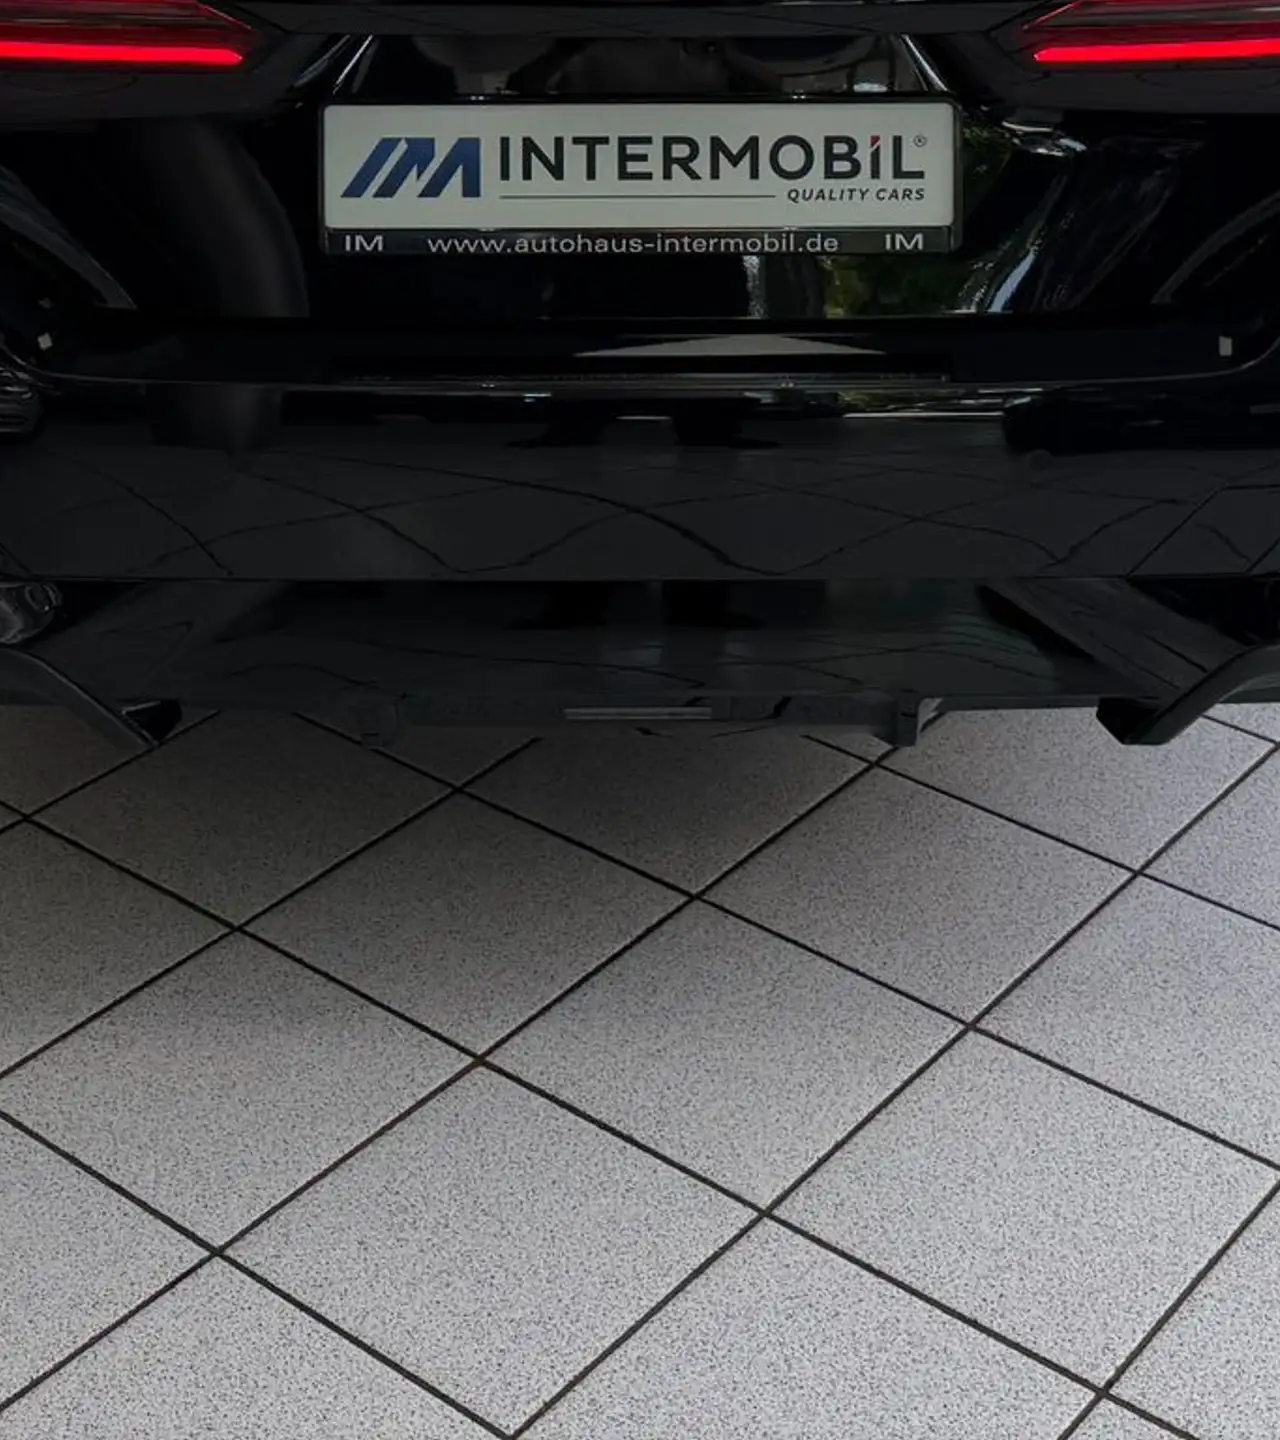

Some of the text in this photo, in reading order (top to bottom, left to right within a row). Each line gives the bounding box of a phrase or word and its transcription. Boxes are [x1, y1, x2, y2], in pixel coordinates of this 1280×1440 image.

[786, 187, 925, 203] QUALITY CARS
[345, 232, 924, 254] IM www.autohaus-intermobil.de IM
